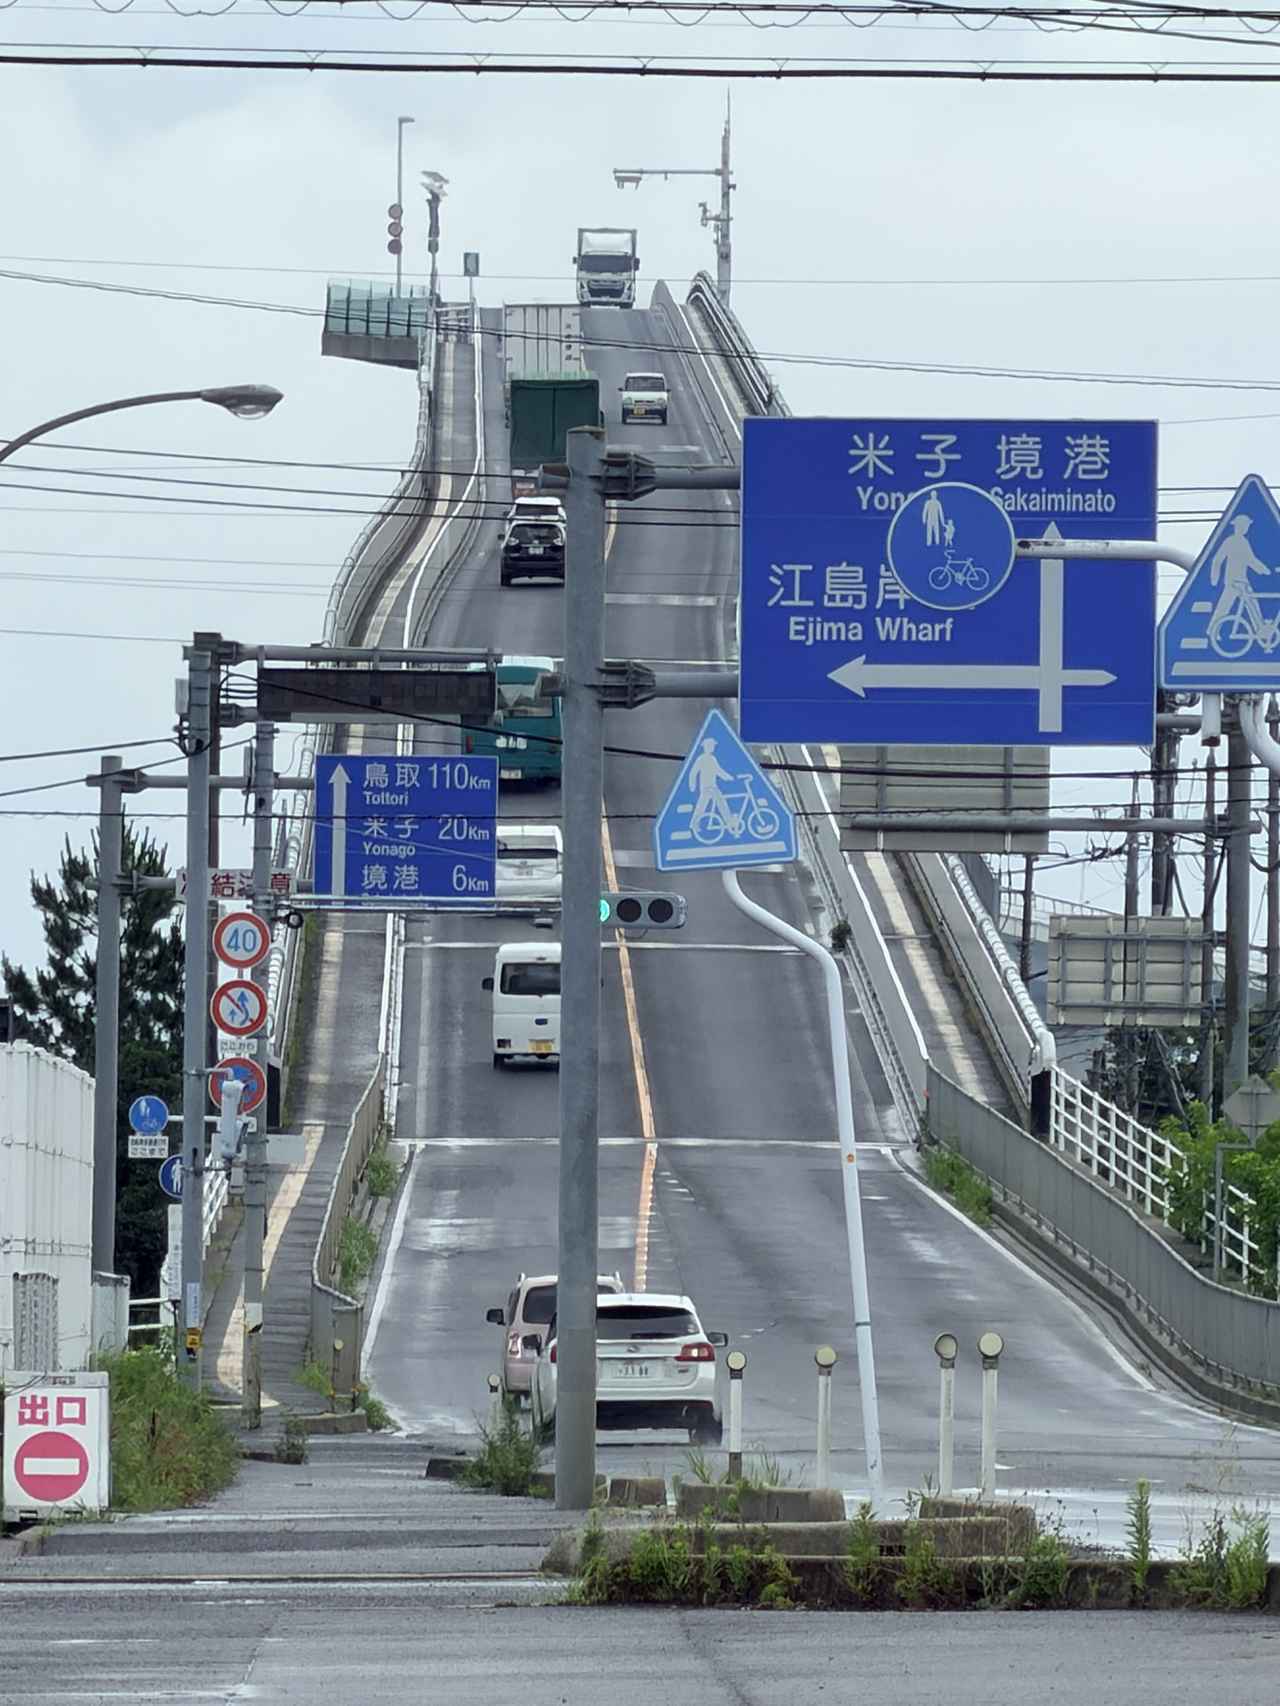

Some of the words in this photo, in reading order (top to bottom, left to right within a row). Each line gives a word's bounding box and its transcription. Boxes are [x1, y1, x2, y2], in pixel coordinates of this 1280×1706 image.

[848, 432, 962, 479] 米子
[995, 433, 1111, 480] 境港
[856, 486, 914, 511] Yon
[767, 562, 913, 610] 江島岸
[789, 616, 864, 646] Ejima
[875, 616, 954, 642] Wharf
[363, 762, 420, 788] 鳥取
[363, 791, 409, 806] Tottori
[363, 813, 419, 839] 米子
[363, 841, 416, 859] Yonago
[361, 864, 419, 891] 境港
[226, 927, 258, 953] 40
[18, 1394, 87, 1426] 出口
